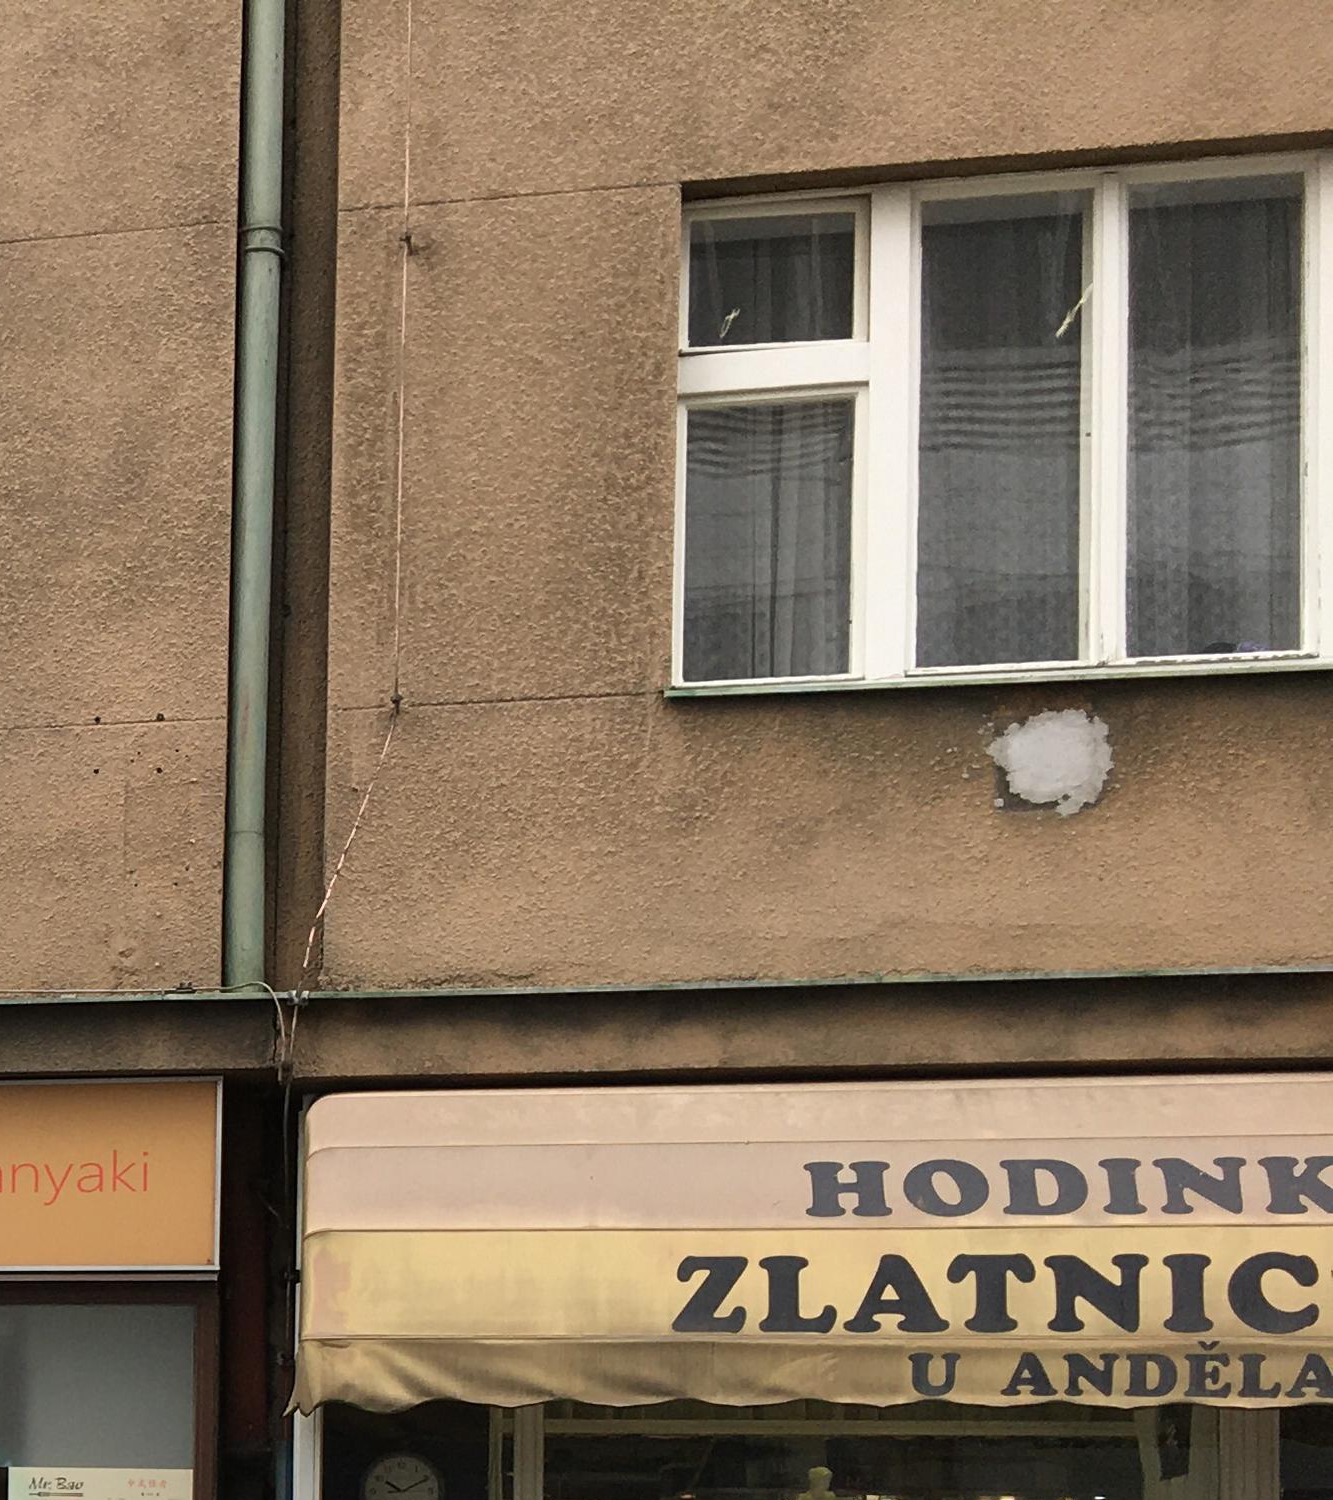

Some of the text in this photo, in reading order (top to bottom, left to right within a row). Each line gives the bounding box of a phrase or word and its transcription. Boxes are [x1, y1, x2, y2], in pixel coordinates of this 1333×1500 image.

[907, 1341, 1333, 1399] U ANDĚLA
[28, 1476, 84, 1491] Mr. Bao
